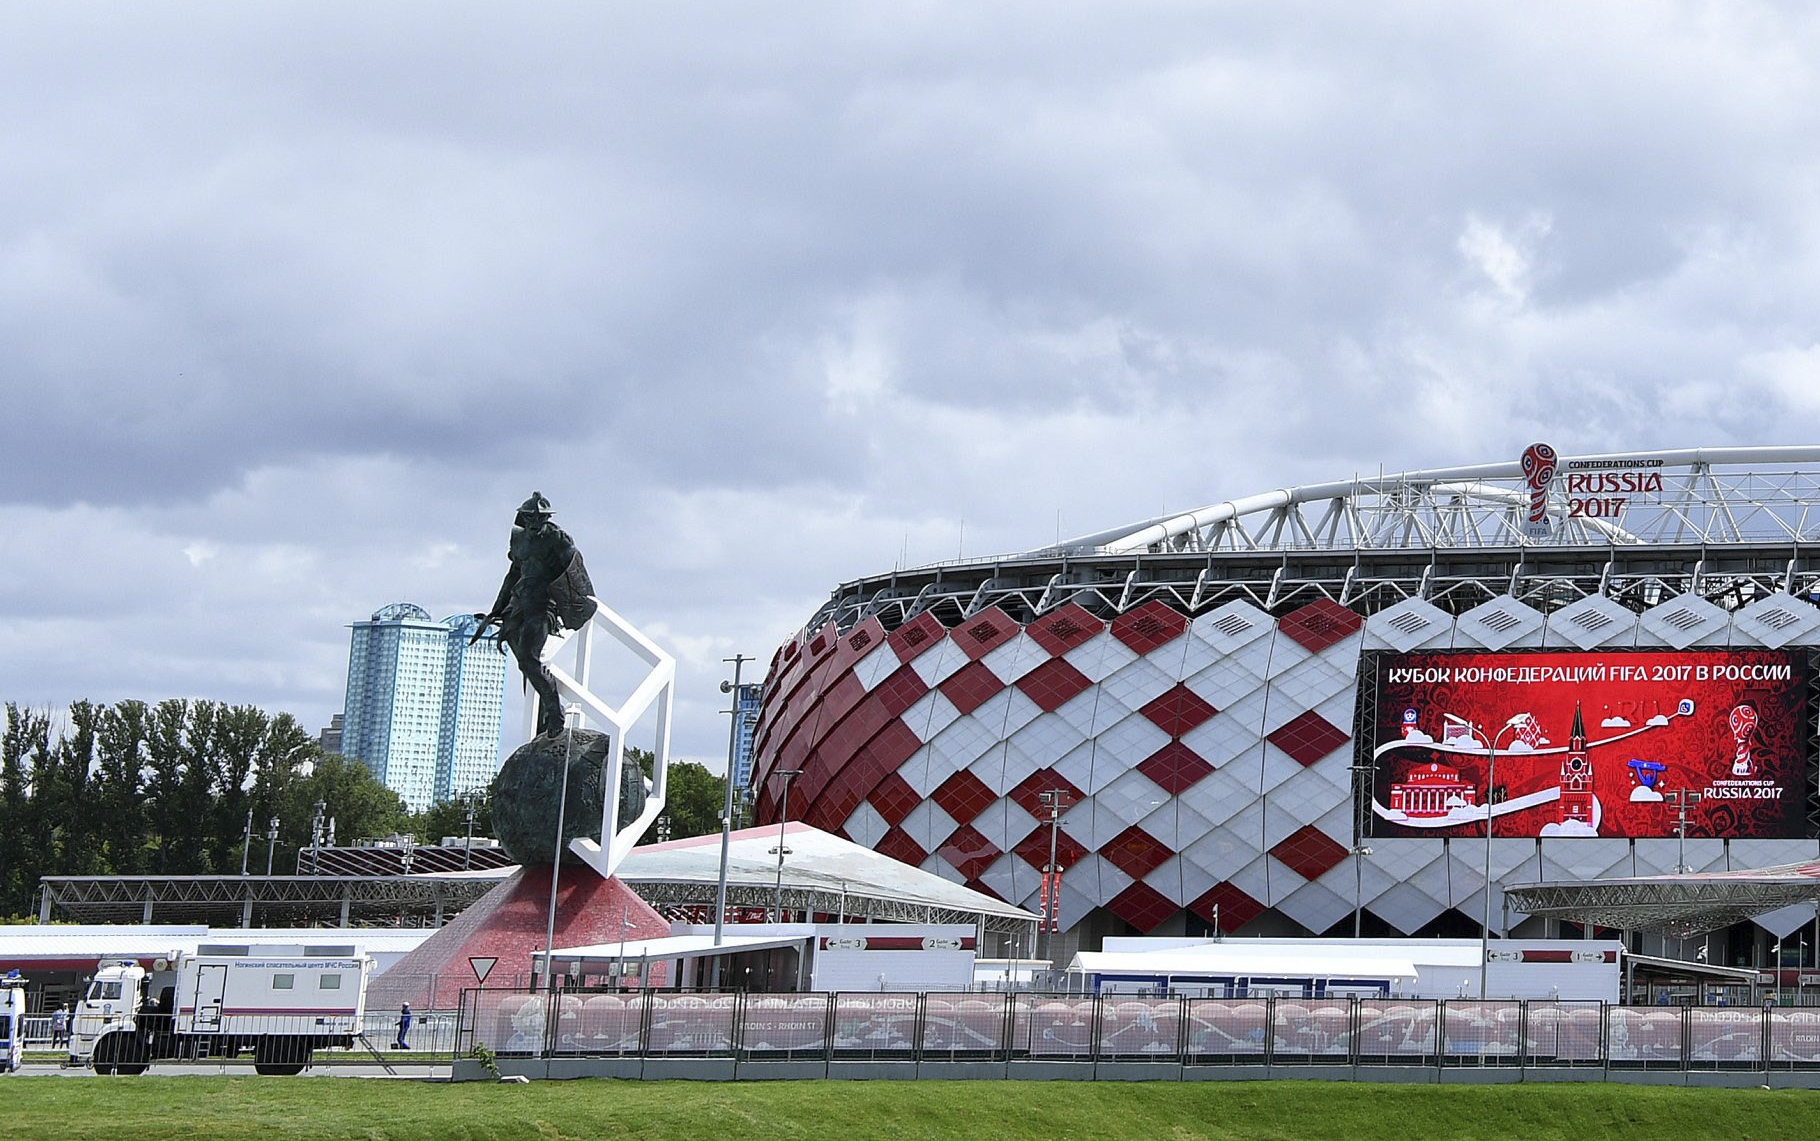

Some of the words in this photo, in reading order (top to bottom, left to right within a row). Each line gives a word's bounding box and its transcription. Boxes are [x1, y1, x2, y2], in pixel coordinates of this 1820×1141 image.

[1568, 459, 1645, 469] CONFEDERATIONS
[1645, 459, 1664, 468] CUP
[1567, 471, 1664, 494] RUSSIA
[1567, 497, 1626, 519] 2017
[1529, 527, 1547, 535] FIFA
[1388, 667, 1451, 684] КУБОК
[1454, 662, 1606, 685] КОНФЕДЕРАЦИЙ
[1609, 666, 1649, 682] FIFA
[1651, 665, 1692, 682] 2017
[1695, 665, 1709, 681] В
[1712, 664, 1791, 682] РОССИИ
[1703, 787, 1752, 799] RUSSIA
[1753, 787, 1783, 799] 2017
[854, 939, 861, 948] 3
[929, 939, 936, 948] 2
[1512, 952, 1519, 960] 3
[266, 960, 307, 968] спасательный
[325, 961, 338, 969] МЧС
[338, 961, 359, 969] России
